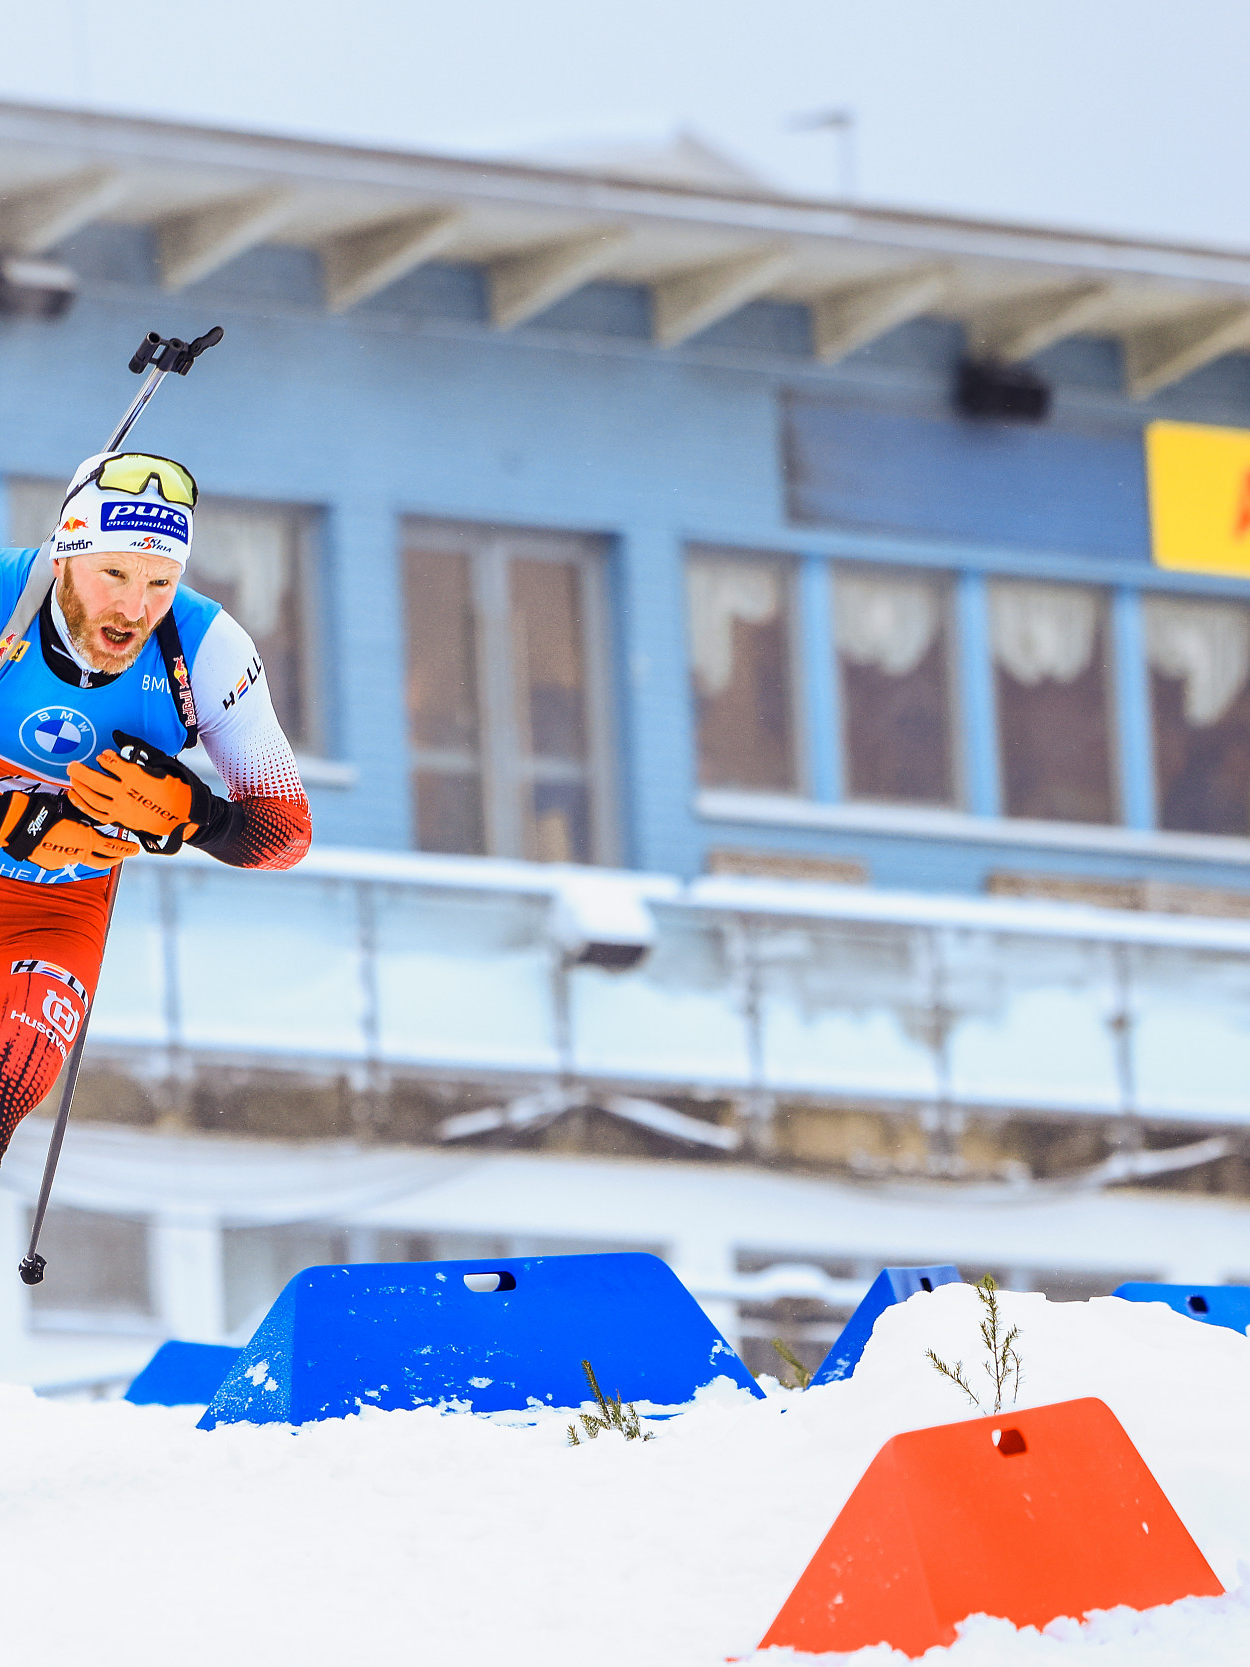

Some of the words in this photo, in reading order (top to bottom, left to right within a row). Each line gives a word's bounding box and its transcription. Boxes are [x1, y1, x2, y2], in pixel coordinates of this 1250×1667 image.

[108, 504, 186, 527] pure
[106, 520, 186, 538] encapsulations
[56, 539, 93, 552] Eisbär
[37, 710, 91, 733] BMW
[10, 1009, 67, 1060] Husqva
